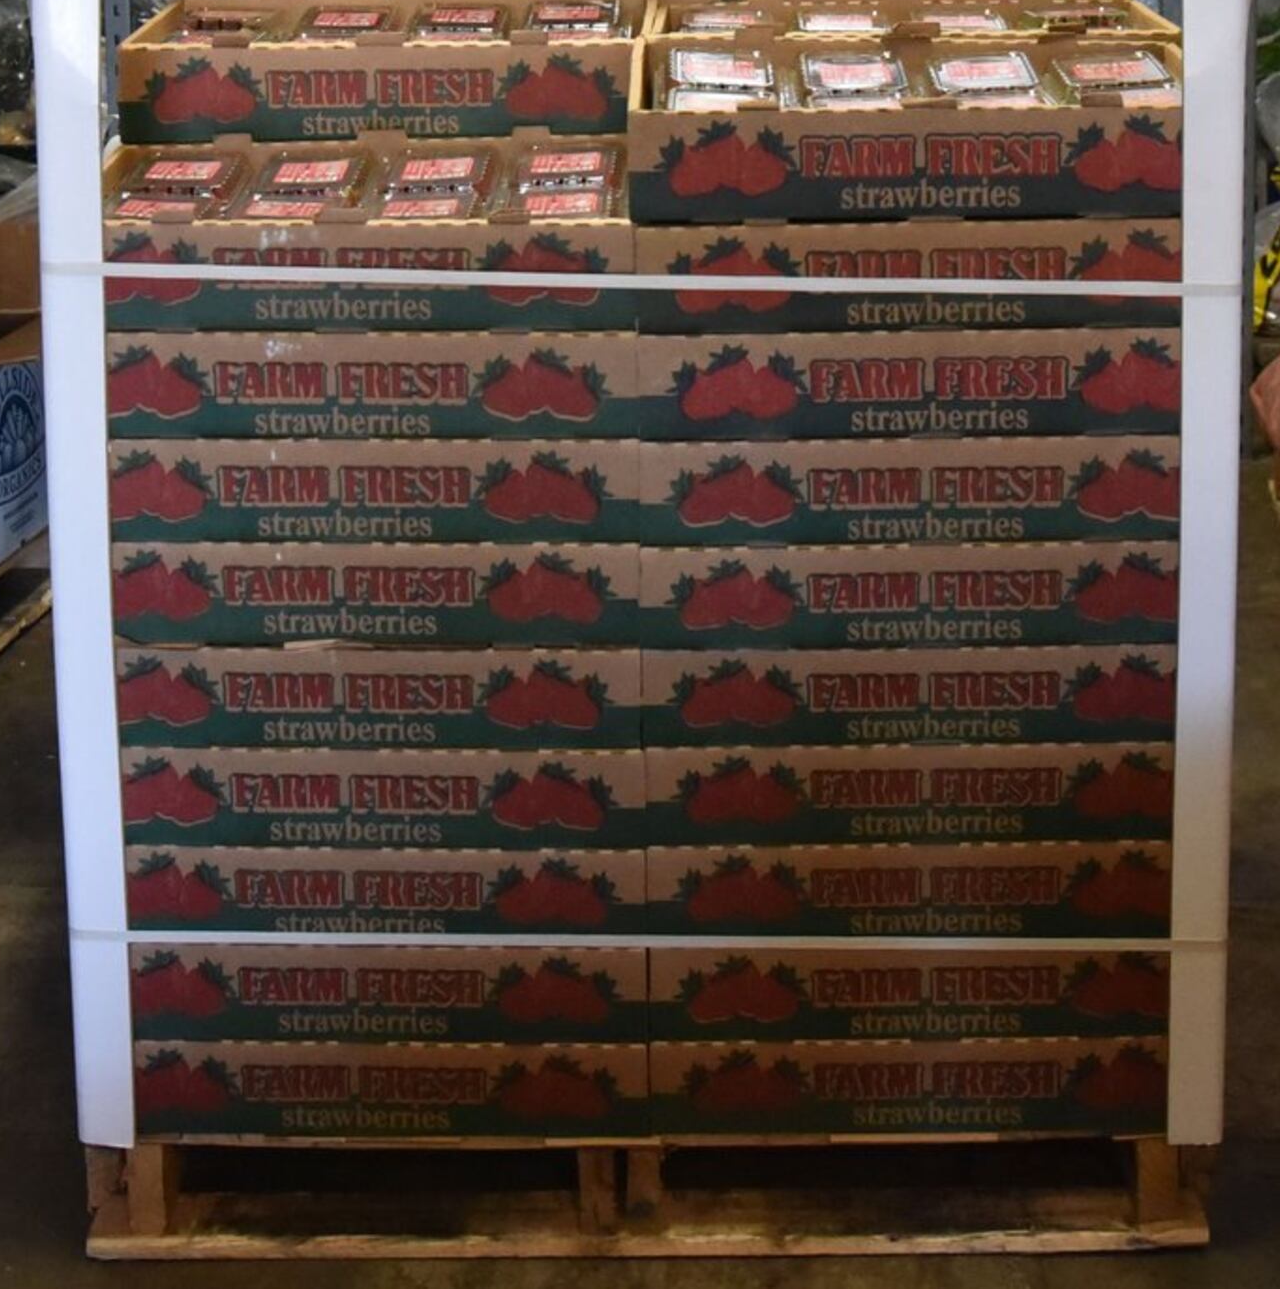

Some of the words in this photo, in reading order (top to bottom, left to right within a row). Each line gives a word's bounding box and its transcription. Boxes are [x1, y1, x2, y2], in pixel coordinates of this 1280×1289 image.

[266, 69, 368, 108] FARM
[377, 69, 495, 108] FRESH
[799, 134, 916, 178] FARM
[925, 134, 1062, 178] FRESH
[840, 179, 1021, 209] strawberries
[213, 362, 327, 404] FARM
[336, 362, 469, 405] FRESH
[808, 359, 924, 402] FARM
[934, 358, 1069, 402] FRESH
[255, 409, 431, 437] strawberries
[851, 404, 1030, 432] strawberries
[217, 465, 331, 507] FARM
[339, 466, 471, 507] FRESH
[808, 468, 920, 510] FARM
[931, 467, 1064, 509] FRESH
[257, 511, 433, 538] strawberries
[848, 511, 1025, 540] strawberries
[223, 565, 337, 606] FARM
[344, 566, 475, 607] FRESH
[807, 572, 920, 613] FARM
[930, 570, 1063, 611] FRESH
[263, 609, 437, 635] strawberries
[847, 614, 1023, 642] strawberries
[223, 672, 335, 713] FARM
[343, 673, 475, 713] FRESH
[807, 672, 920, 712] FARM
[930, 671, 1061, 711] FRESH
[263, 716, 437, 743] strawberries
[847, 713, 1022, 740] strawberries
[229, 773, 342, 813] FARM
[349, 774, 481, 813] FRESH
[809, 768, 922, 809] FARM
[931, 767, 1062, 806] FRESH
[270, 817, 442, 844] strawberries
[850, 809, 1023, 837] strawberries
